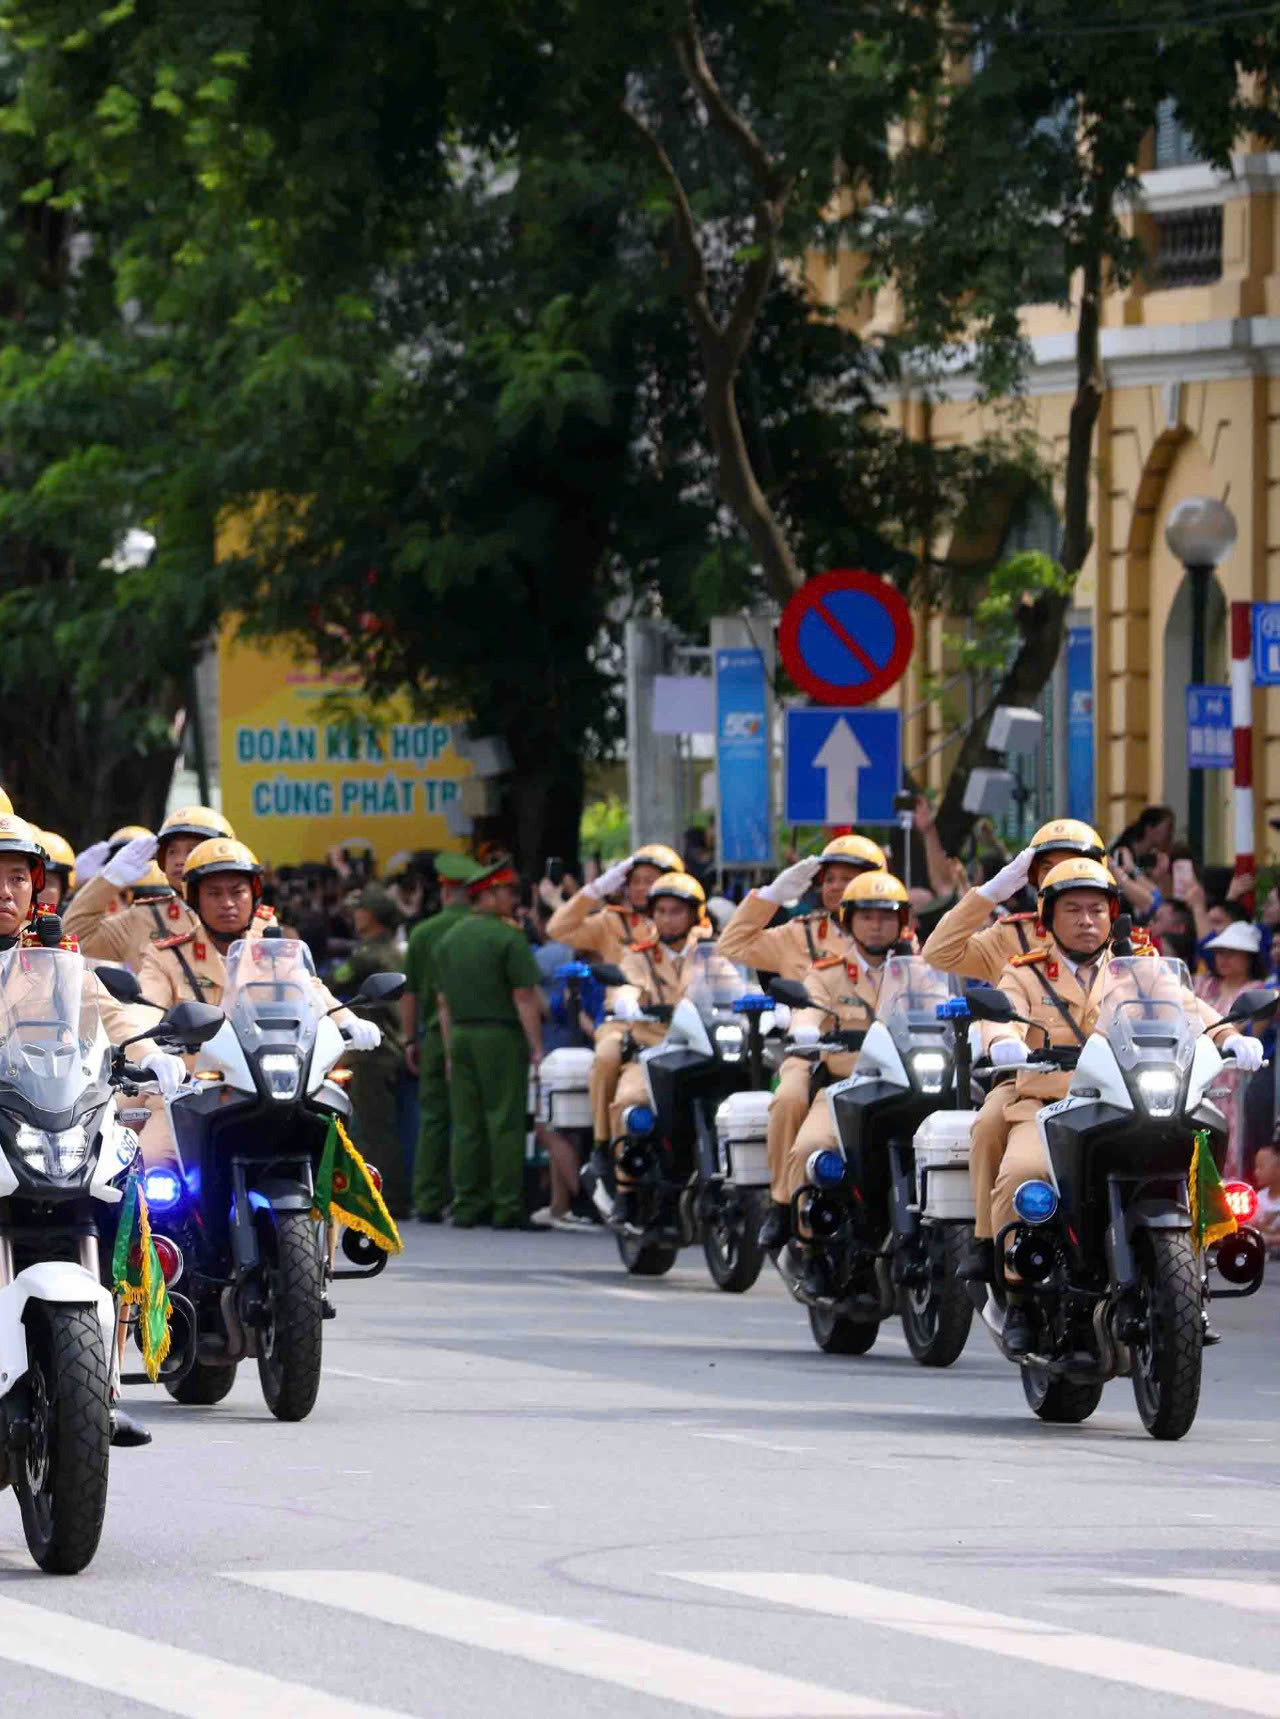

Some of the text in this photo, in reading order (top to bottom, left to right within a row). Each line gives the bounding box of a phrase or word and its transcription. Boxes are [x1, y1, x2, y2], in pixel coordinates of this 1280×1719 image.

[235, 720, 316, 761] ĐOÀN
[252, 773, 334, 815] CÙNG
[340, 769, 416, 813] PHÁT
[116, 1128, 138, 1166] CSGT
